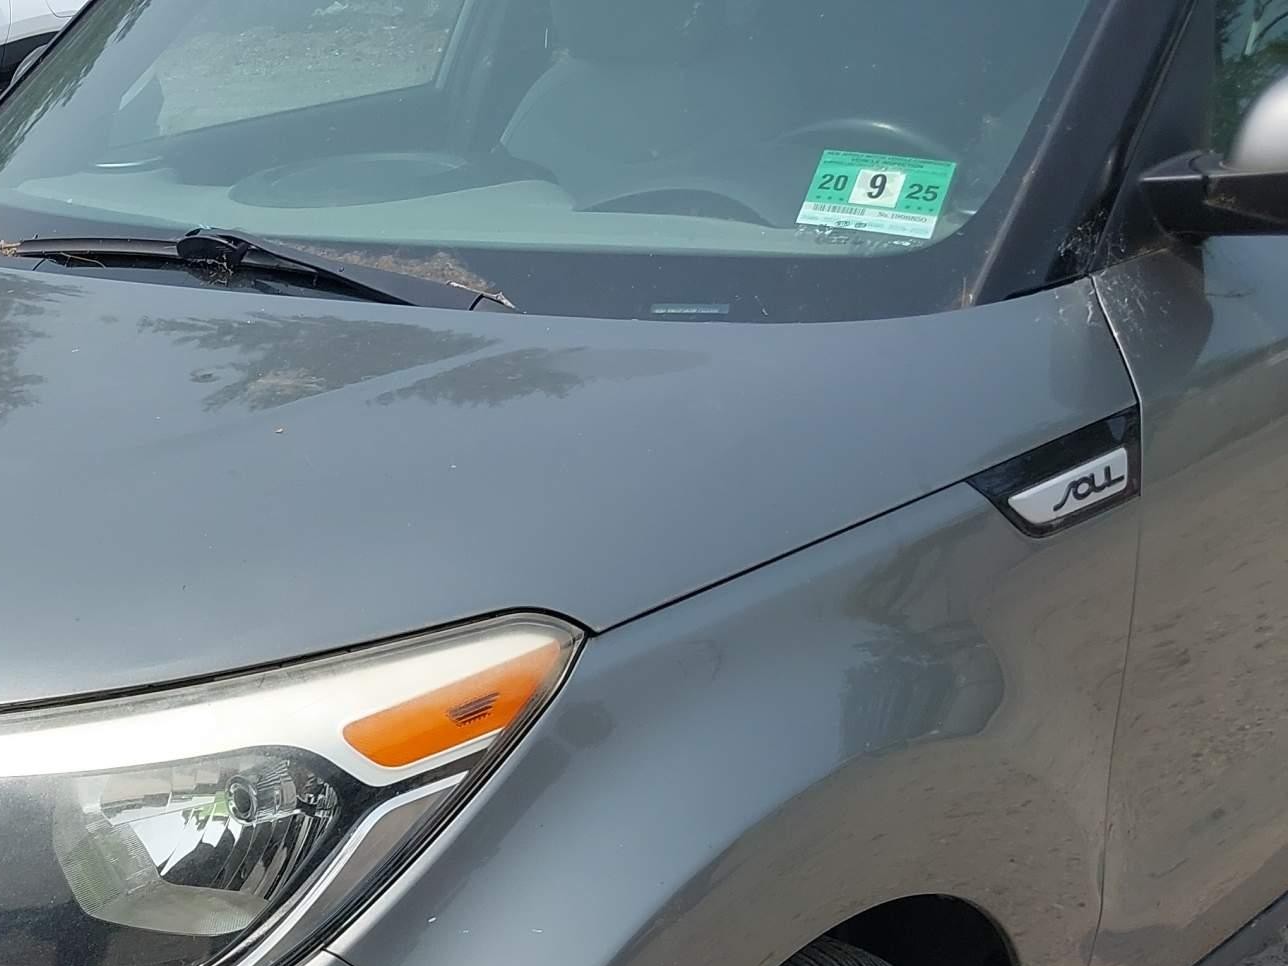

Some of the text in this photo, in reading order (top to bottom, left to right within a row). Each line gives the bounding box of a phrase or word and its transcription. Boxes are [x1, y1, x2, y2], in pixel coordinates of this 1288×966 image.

[818, 173, 940, 202] 20 9 25
[1053, 465, 1125, 512] SOUL
